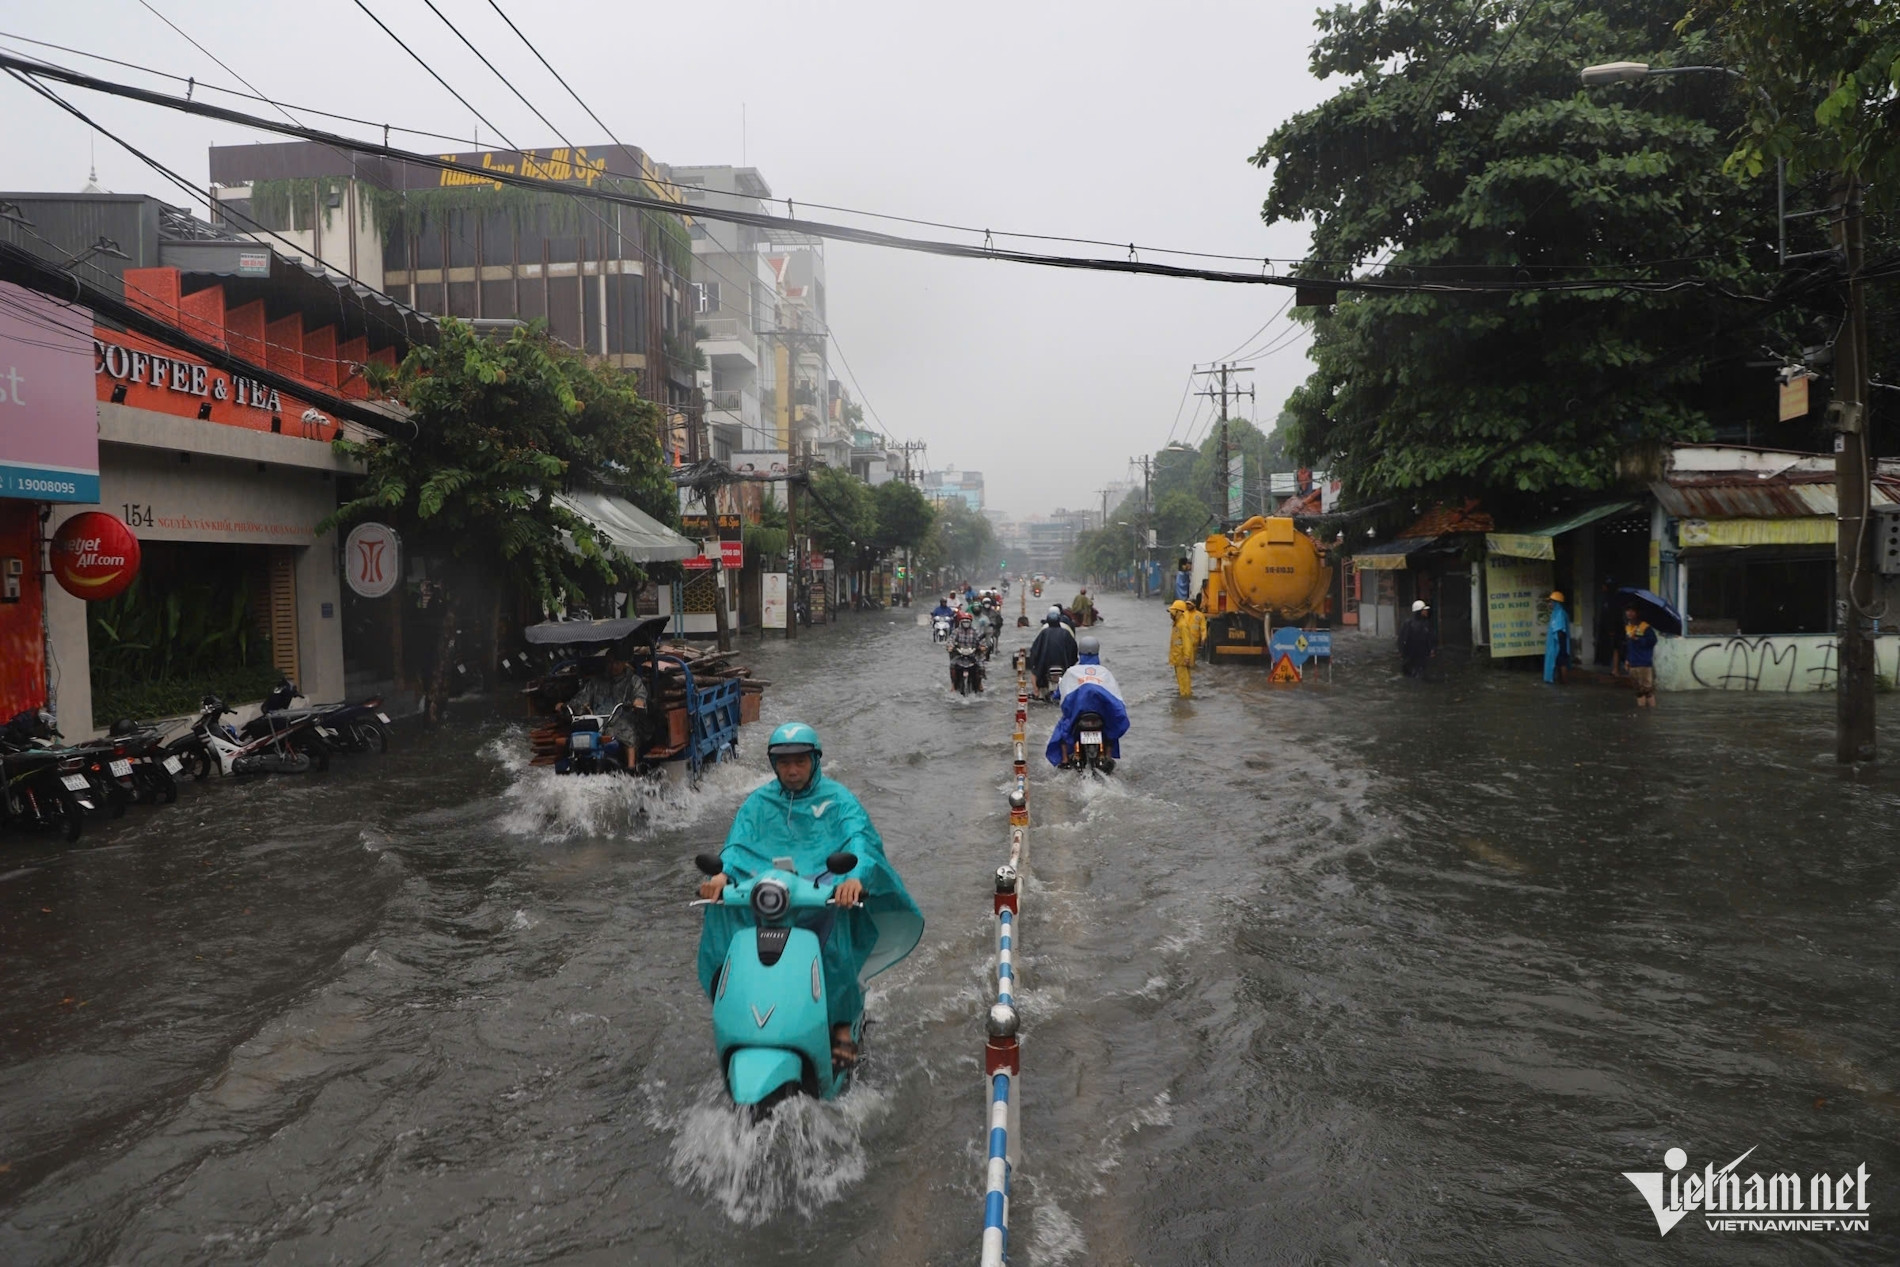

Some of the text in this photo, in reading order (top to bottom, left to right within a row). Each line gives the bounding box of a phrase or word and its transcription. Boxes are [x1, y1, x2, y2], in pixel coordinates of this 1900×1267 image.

[520, 147, 572, 181] Health
[575, 147, 607, 187] Spa
[214, 377, 228, 400] &
[232, 374, 282, 412] TEA
[18, 478, 76, 494] 19008095
[122, 503, 154, 528] 154
